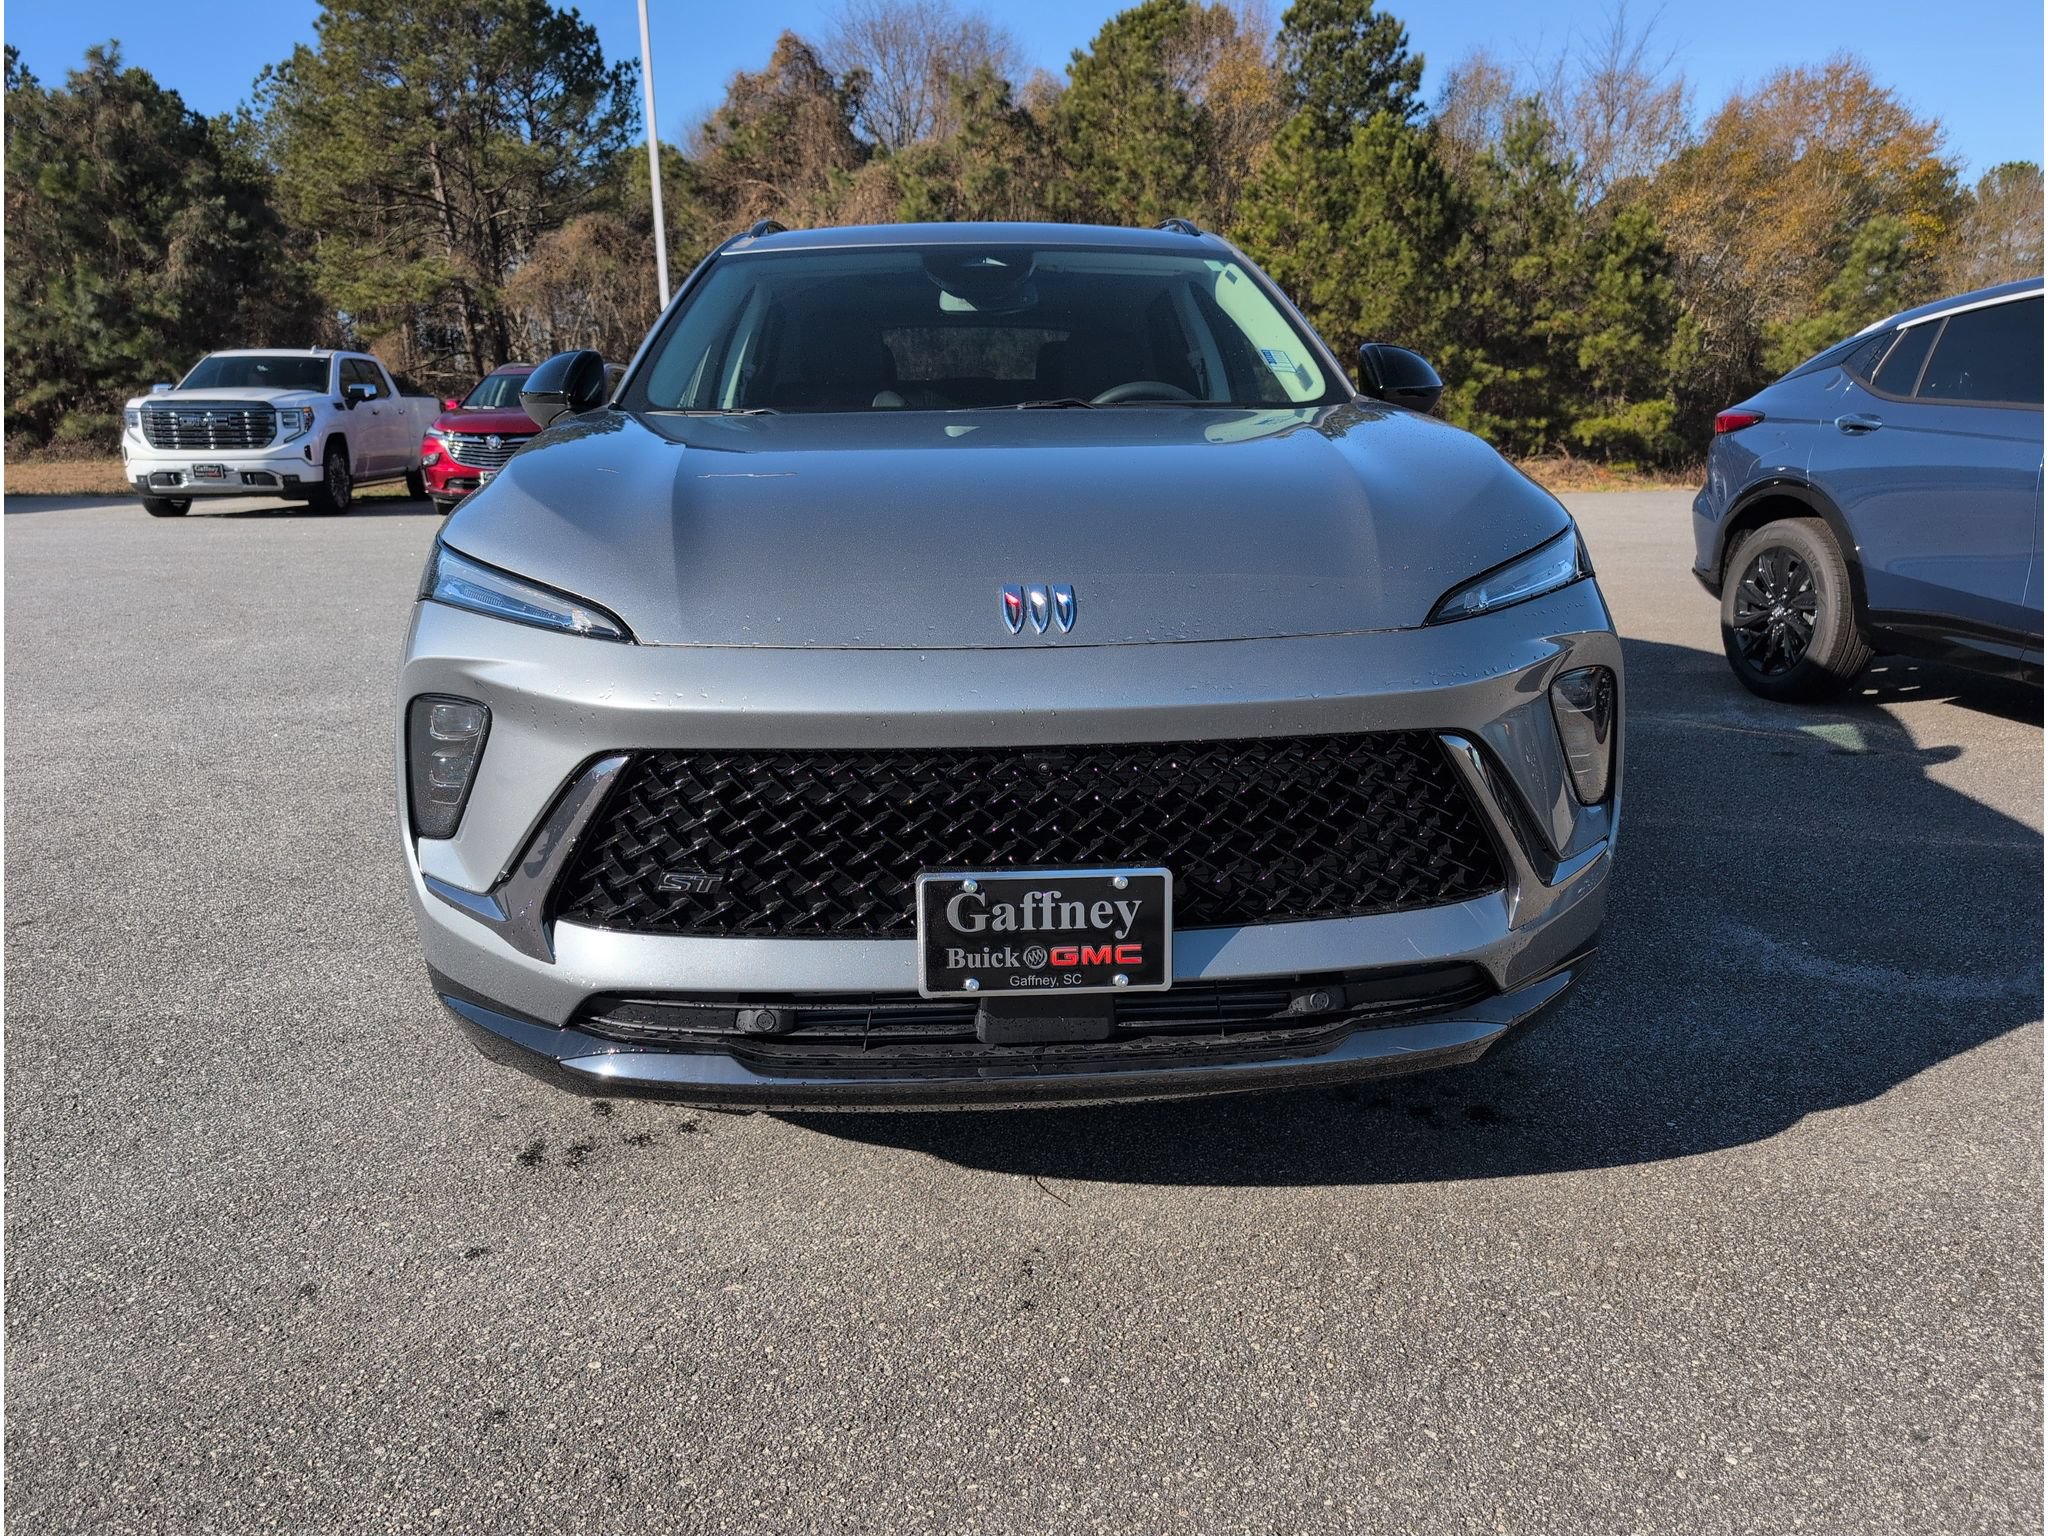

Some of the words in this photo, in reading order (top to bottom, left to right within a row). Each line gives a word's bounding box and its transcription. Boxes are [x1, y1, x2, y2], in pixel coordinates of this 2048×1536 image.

[658, 873, 724, 893] ST
[946, 890, 1143, 940] Gaffney
[945, 946, 1021, 970] Buick
[1050, 943, 1143, 967] GMC
[1009, 974, 1060, 988] Gaffney,
[1063, 973, 1082, 985] SC
